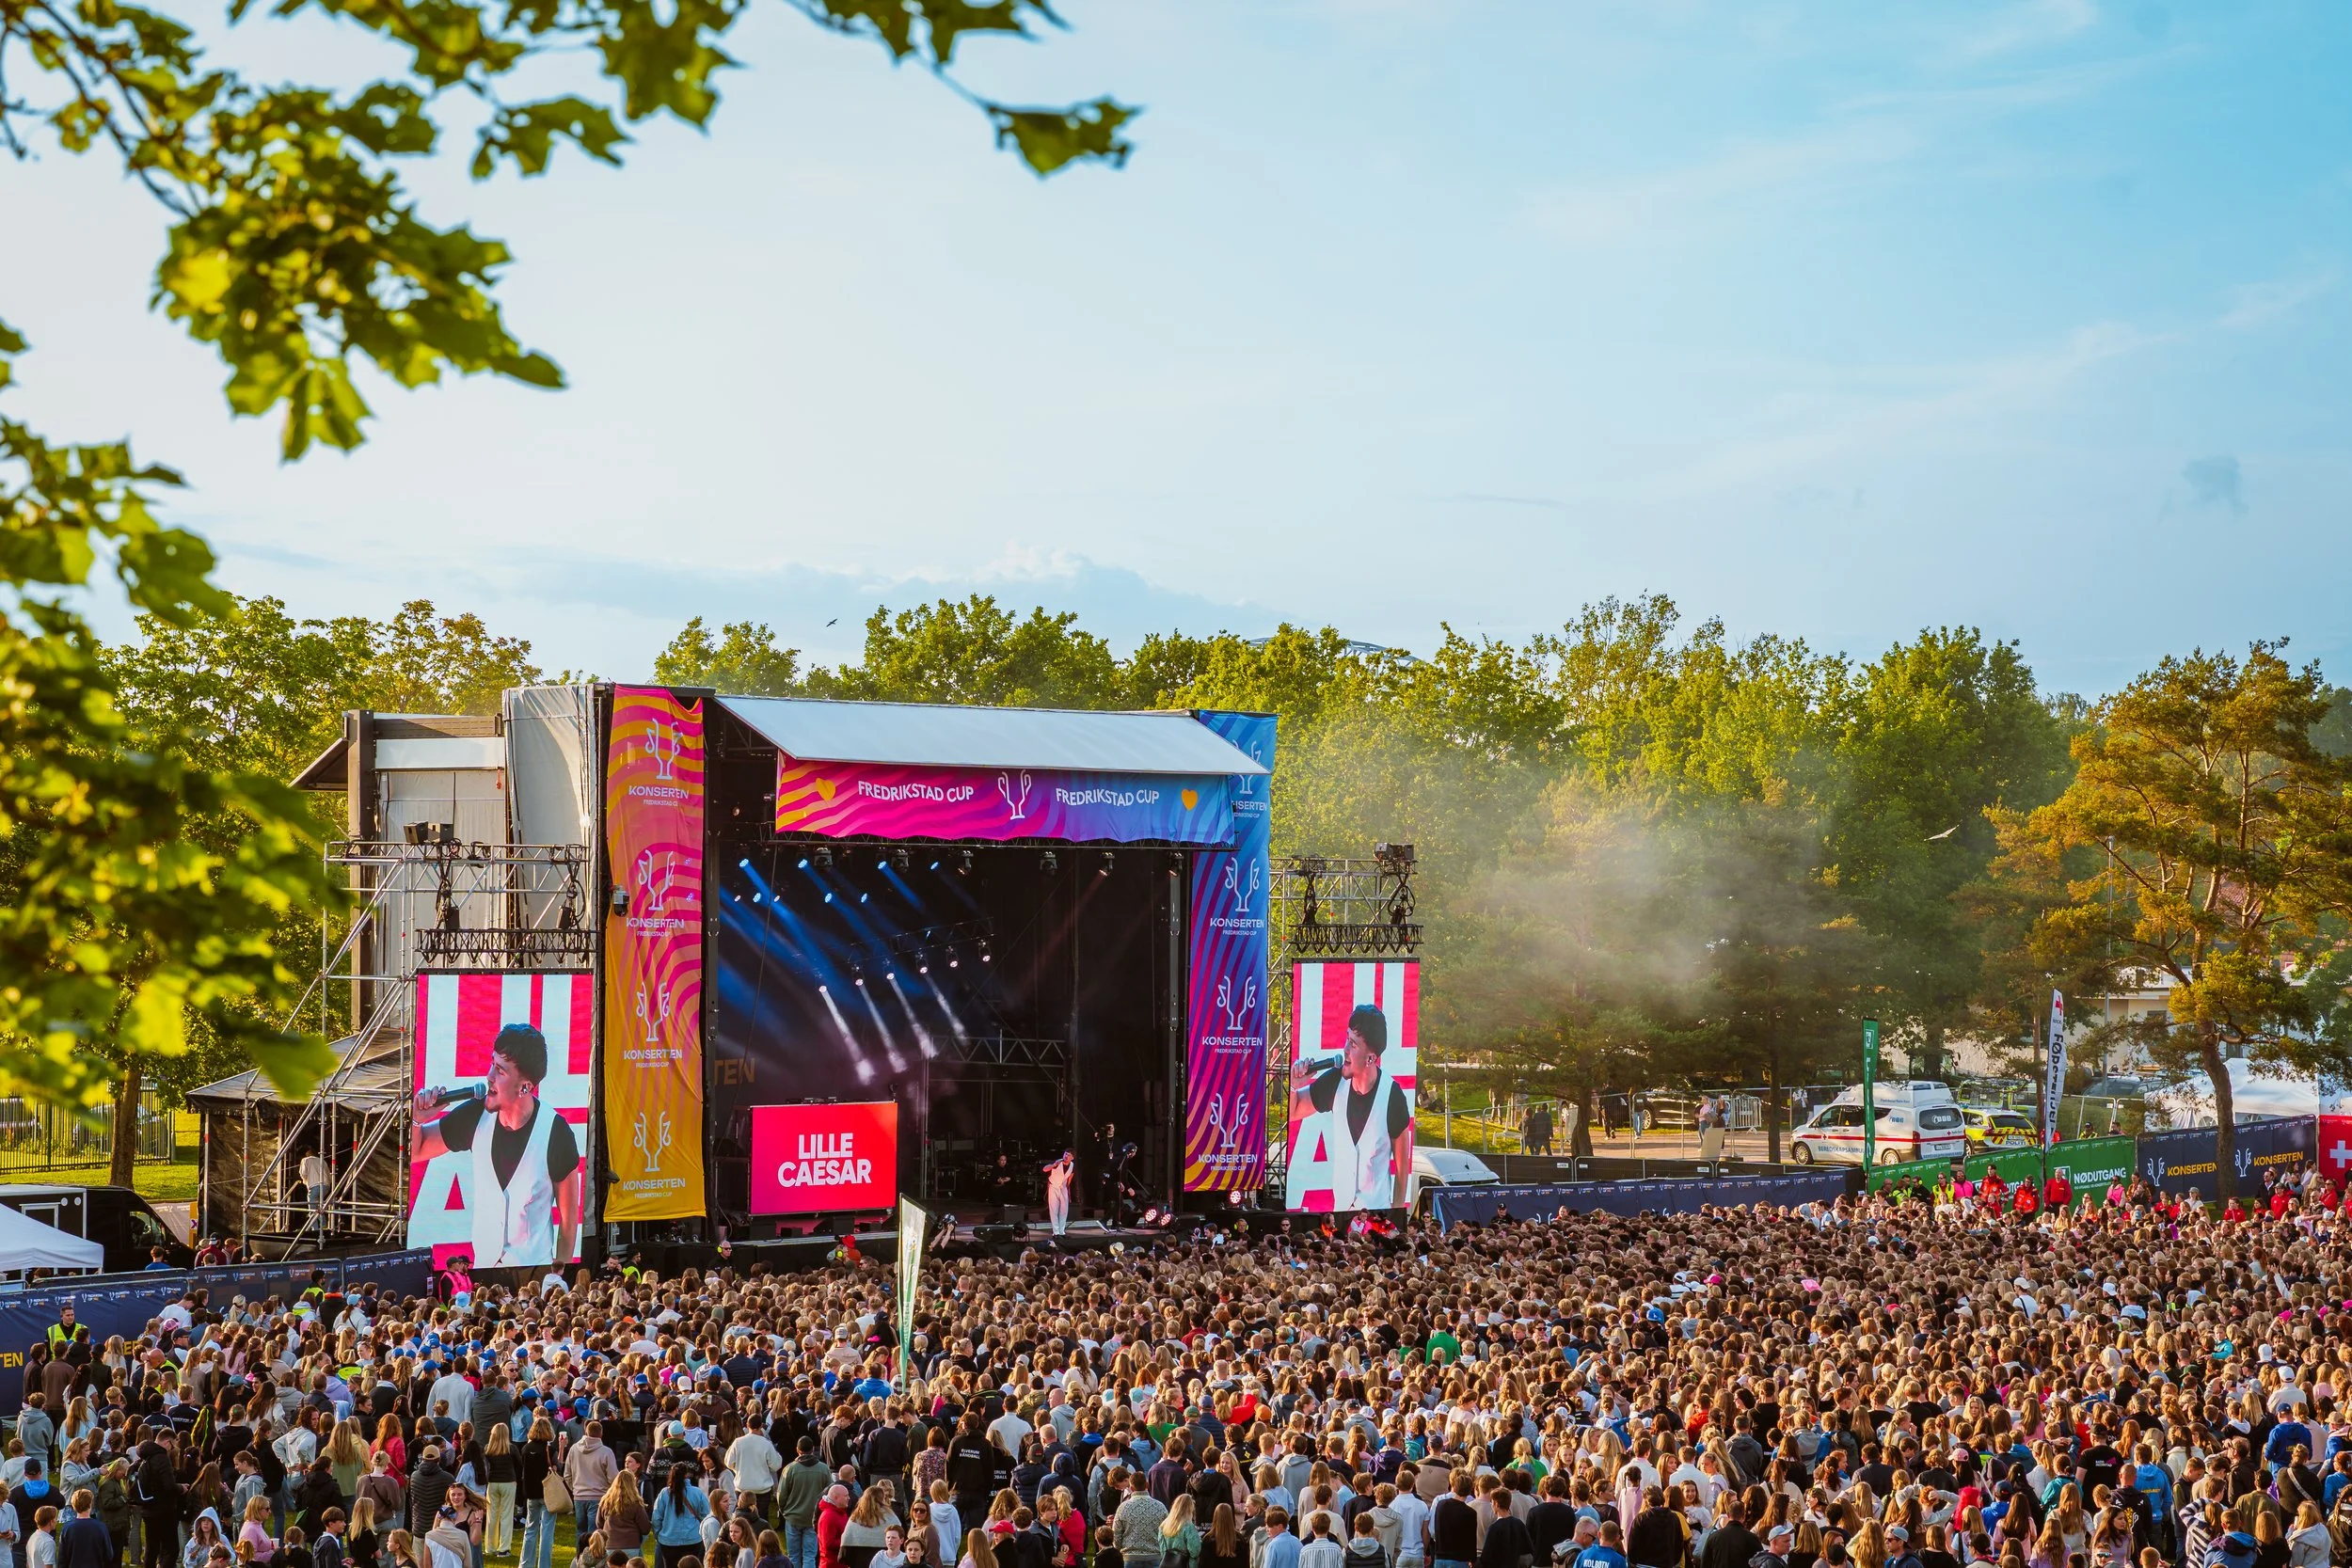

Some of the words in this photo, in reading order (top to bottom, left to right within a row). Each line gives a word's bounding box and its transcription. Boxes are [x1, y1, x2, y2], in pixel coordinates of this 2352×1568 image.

[858, 781, 944, 801] FREDRIKSTAD
[946, 785, 975, 802] CUP
[1056, 787, 1134, 807] FREDRIKSTAD
[1136, 789, 1160, 804] CUP
[1233, 800, 1267, 811] SERTEN
[626, 917, 684, 928] KONSERTEN
[1210, 918, 1264, 928] KONSERTEN
[1202, 1037, 1263, 1046] KONSERTEN
[624, 1049, 682, 1060] KONSERTEN
[798, 1132, 853, 1159] LILLE
[1199, 1154, 1258, 1164] KONSERTEN
[2253, 1151, 2304, 1166] KONSERTEN
[777, 1159, 872, 1187] CAESAR
[2074, 1167, 2126, 1184] NØDUTGANG
[2167, 1162, 2217, 1177] KONSERTEN
[623, 1178, 686, 1191] KONSERTEN
